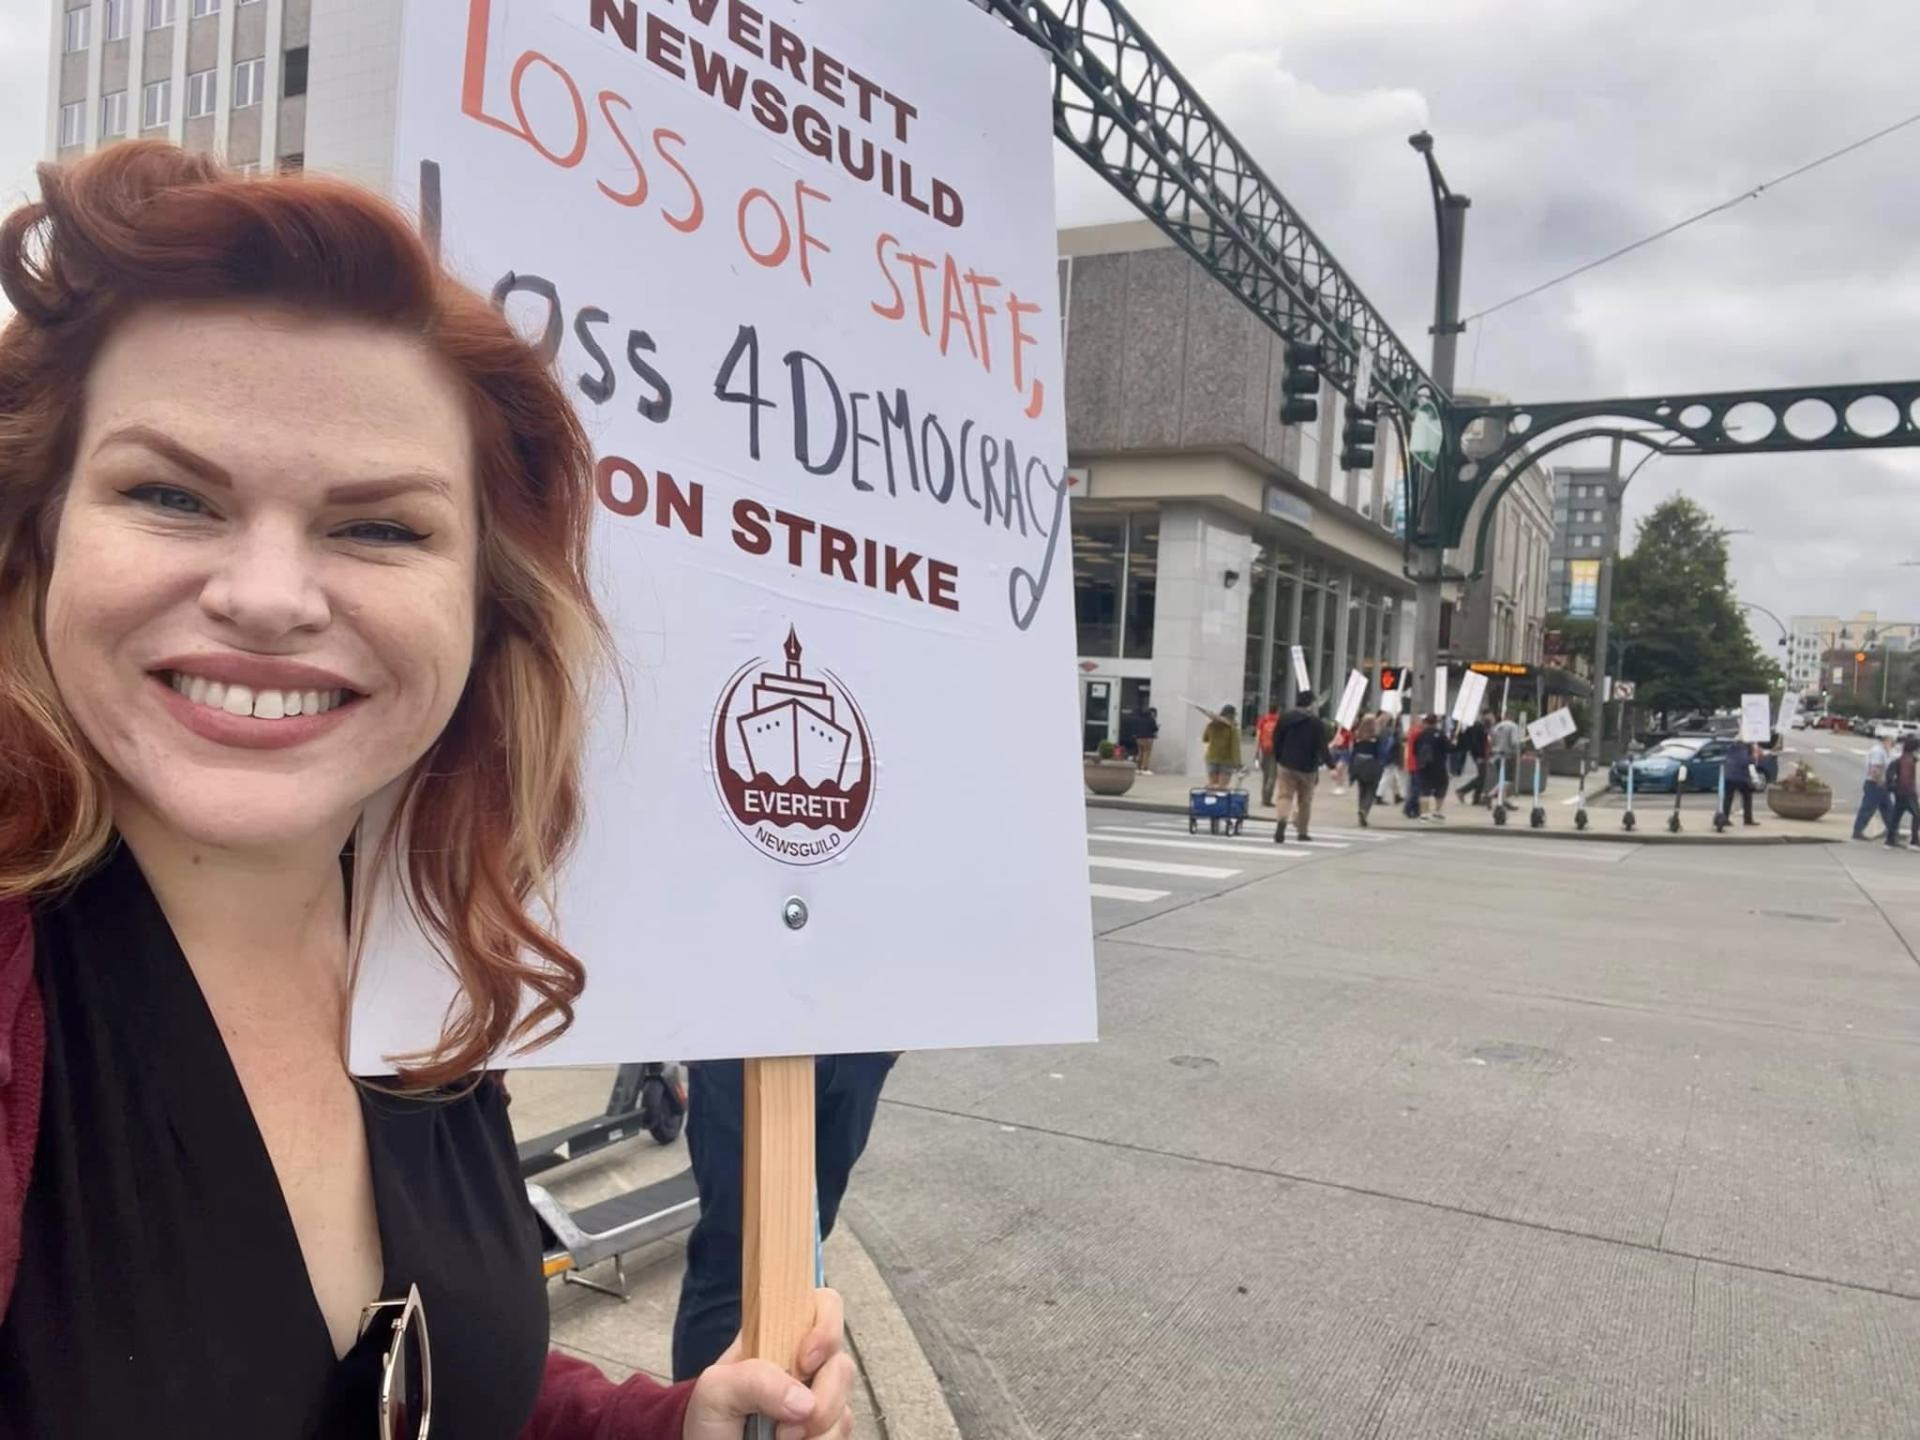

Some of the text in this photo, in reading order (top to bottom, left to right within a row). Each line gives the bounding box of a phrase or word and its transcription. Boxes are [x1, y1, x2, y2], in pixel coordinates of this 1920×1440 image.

[590, 0, 964, 228] NEWSGUILD
[660, 0, 918, 144] VERETT
[461, 0, 1043, 420] LOSS OF STAFF,
[596, 455, 960, 612] ON STRIKE
[744, 789, 849, 819] EVERETT
[756, 827, 841, 857] NEWSGUILD
